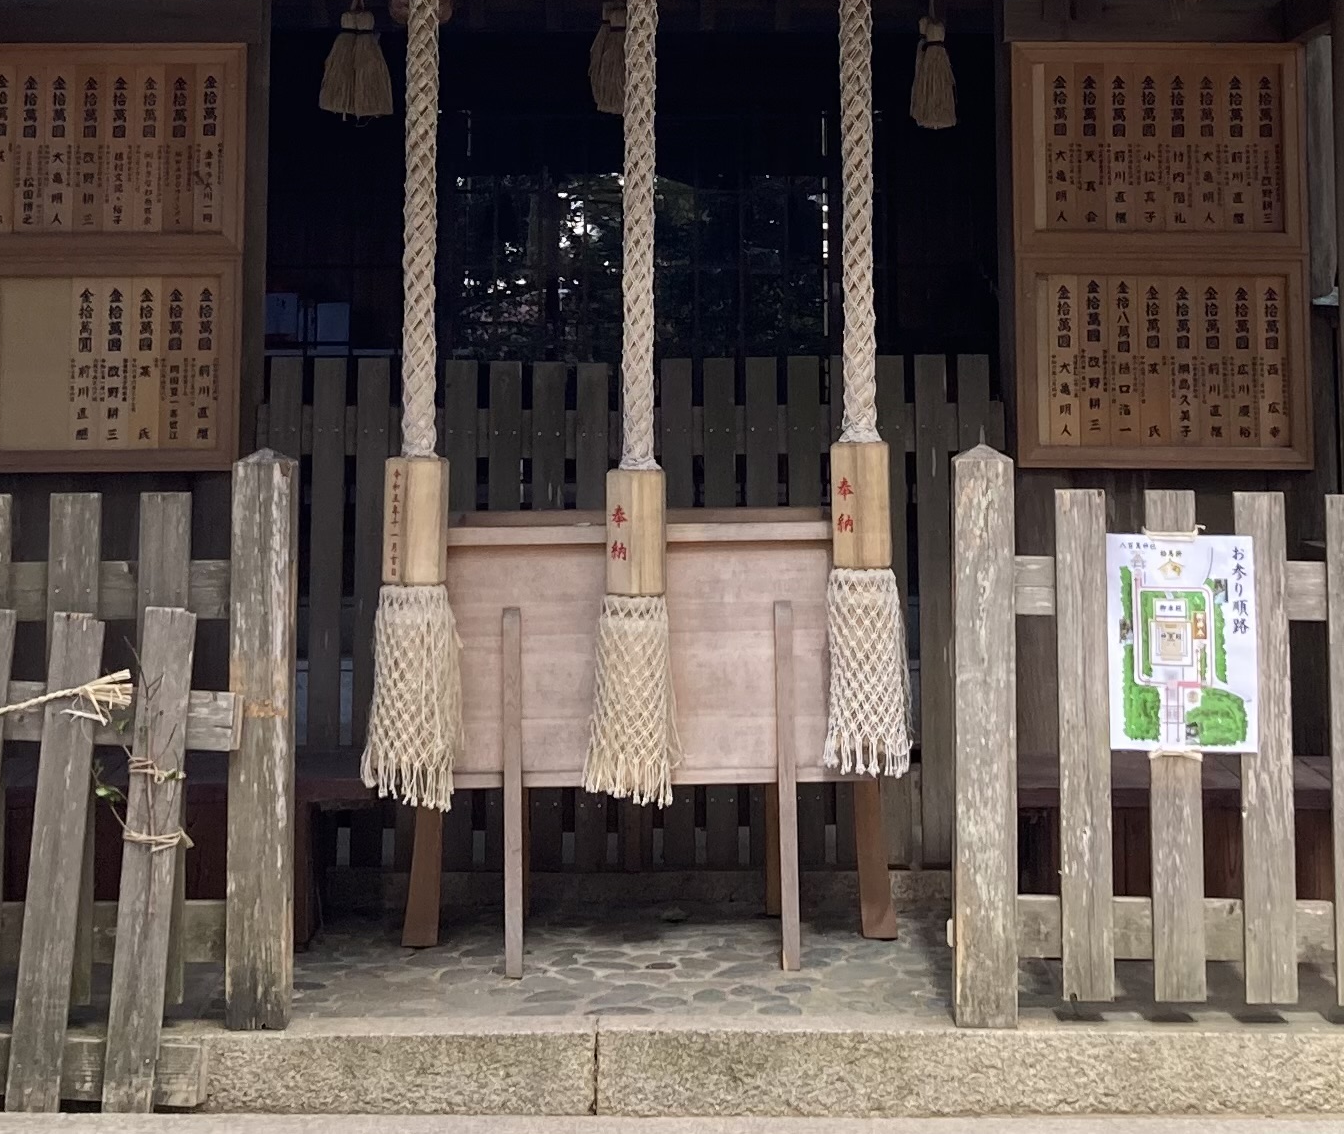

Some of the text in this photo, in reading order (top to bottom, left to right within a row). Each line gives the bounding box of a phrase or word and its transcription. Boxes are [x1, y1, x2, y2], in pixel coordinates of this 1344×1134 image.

[611, 504, 628, 561] 奉納
[837, 476, 855, 534] 奉納
[1231, 546, 1250, 635] お参り順路
